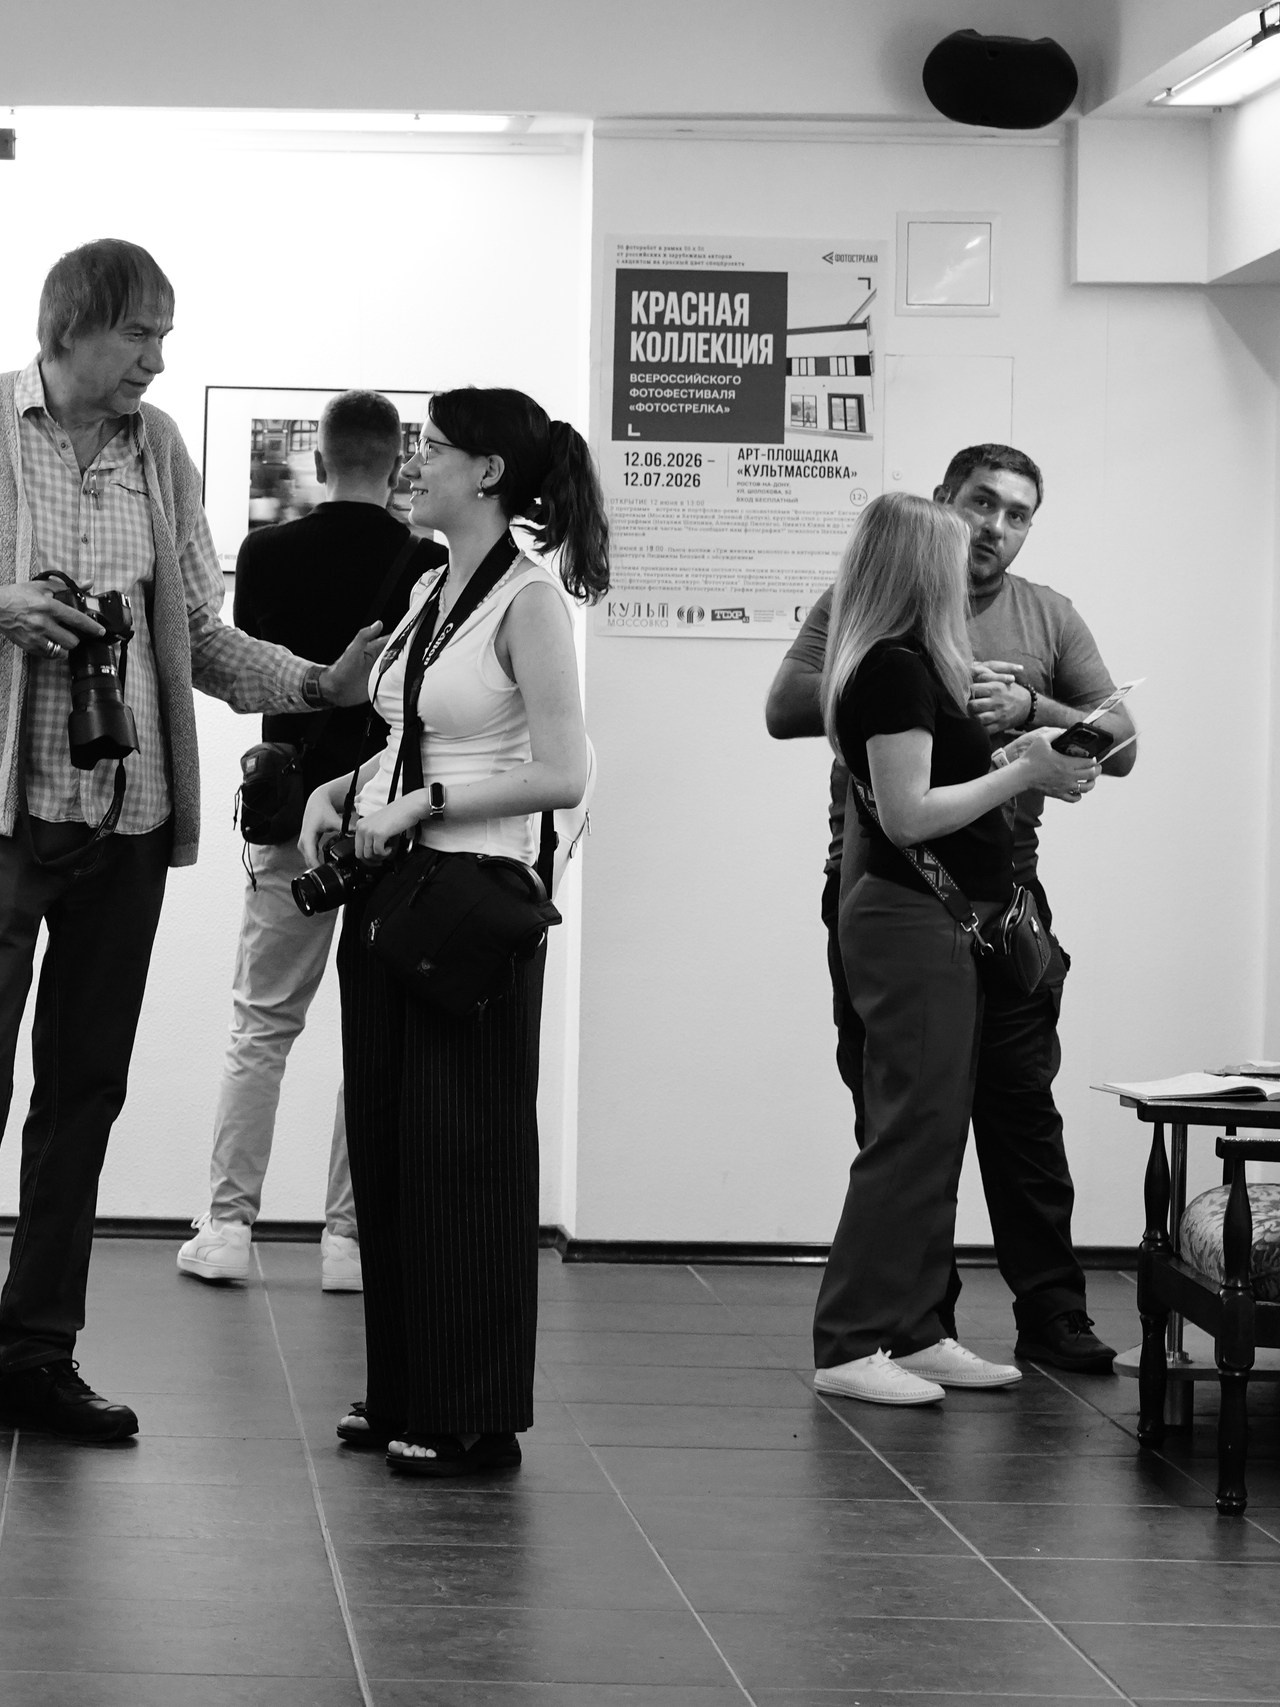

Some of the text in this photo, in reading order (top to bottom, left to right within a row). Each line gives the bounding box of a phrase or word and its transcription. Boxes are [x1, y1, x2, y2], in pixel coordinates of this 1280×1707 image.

[631, 290, 750, 327] КРАСНАЯ
[630, 331, 774, 368] КОЛЛЕКЦИЯ
[630, 373, 742, 386] ВСЕРОССИЙСКОГО
[629, 388, 736, 400] ФОТОФЕСТИВАЛЯ
[629, 402, 730, 414] «ФОТОСТРЕЛКА»
[624, 451, 703, 468] 12.06.2026
[737, 448, 839, 464] АРТ-ПЛОЩАДКА
[623, 471, 701, 488] 12.07.2026
[737, 464, 858, 479] «КУЛЬТМАССОВКА»
[423, 622, 454, 666] Canon
